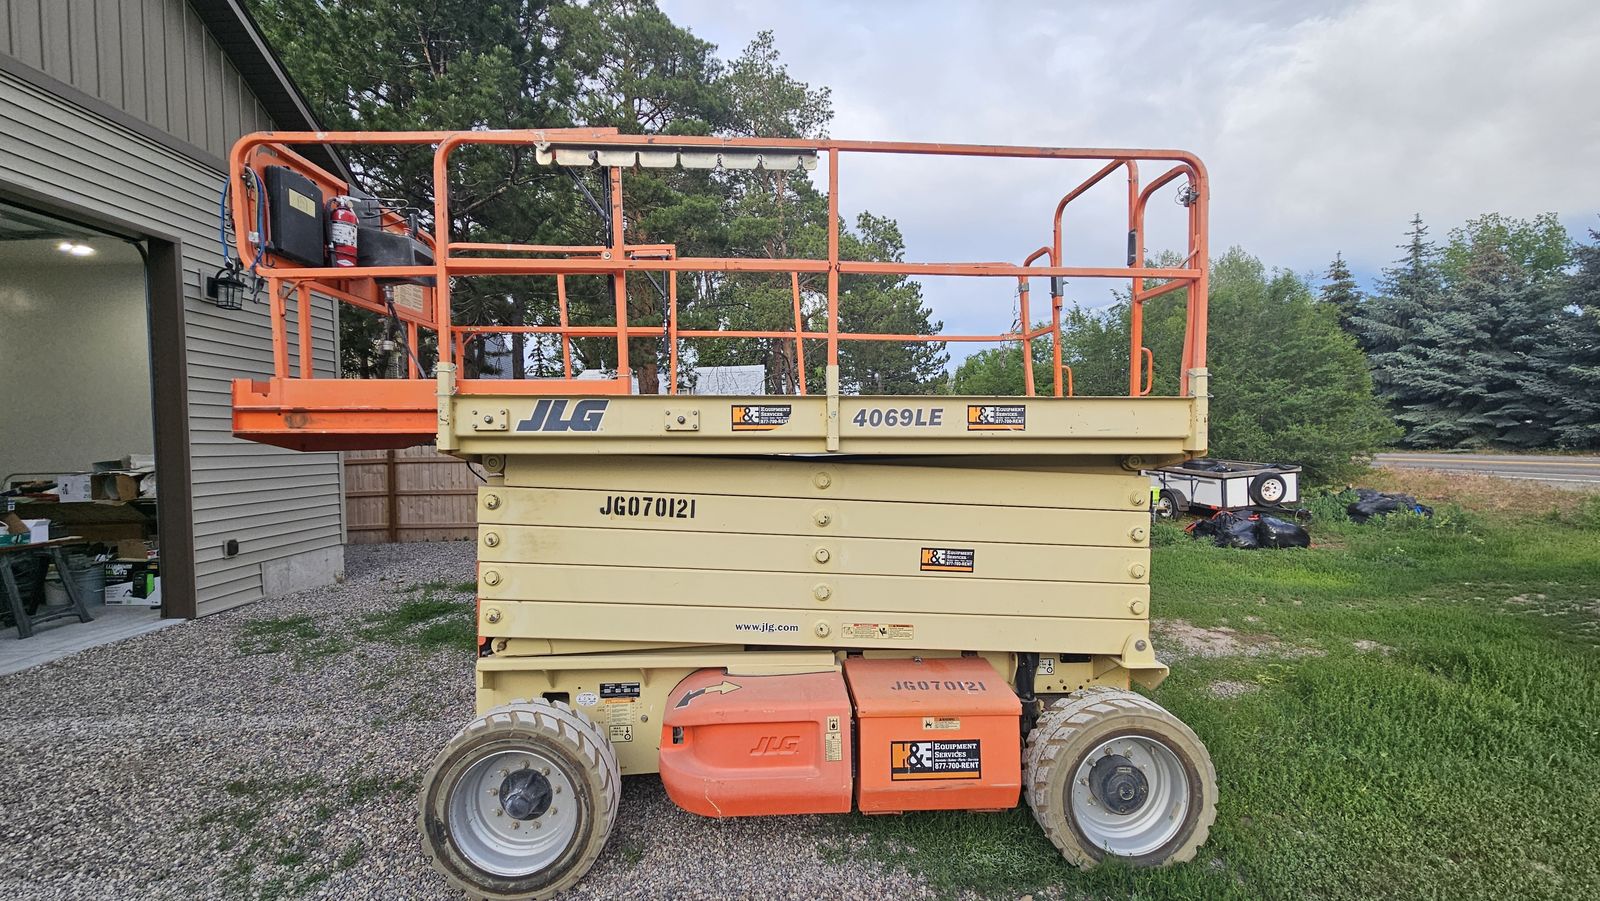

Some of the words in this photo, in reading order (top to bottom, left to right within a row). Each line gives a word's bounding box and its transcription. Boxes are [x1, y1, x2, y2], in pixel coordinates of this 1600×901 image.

[515, 399, 609, 432] JLG
[853, 408, 944, 427] 4069LE
[600, 496, 696, 518] JG070121
[735, 622, 799, 633] www.jlg.com
[890, 681, 987, 691] JG070121
[749, 735, 800, 756] JLG
[892, 743, 932, 768] H&E
[934, 762, 980, 770] 877-700-RENT
